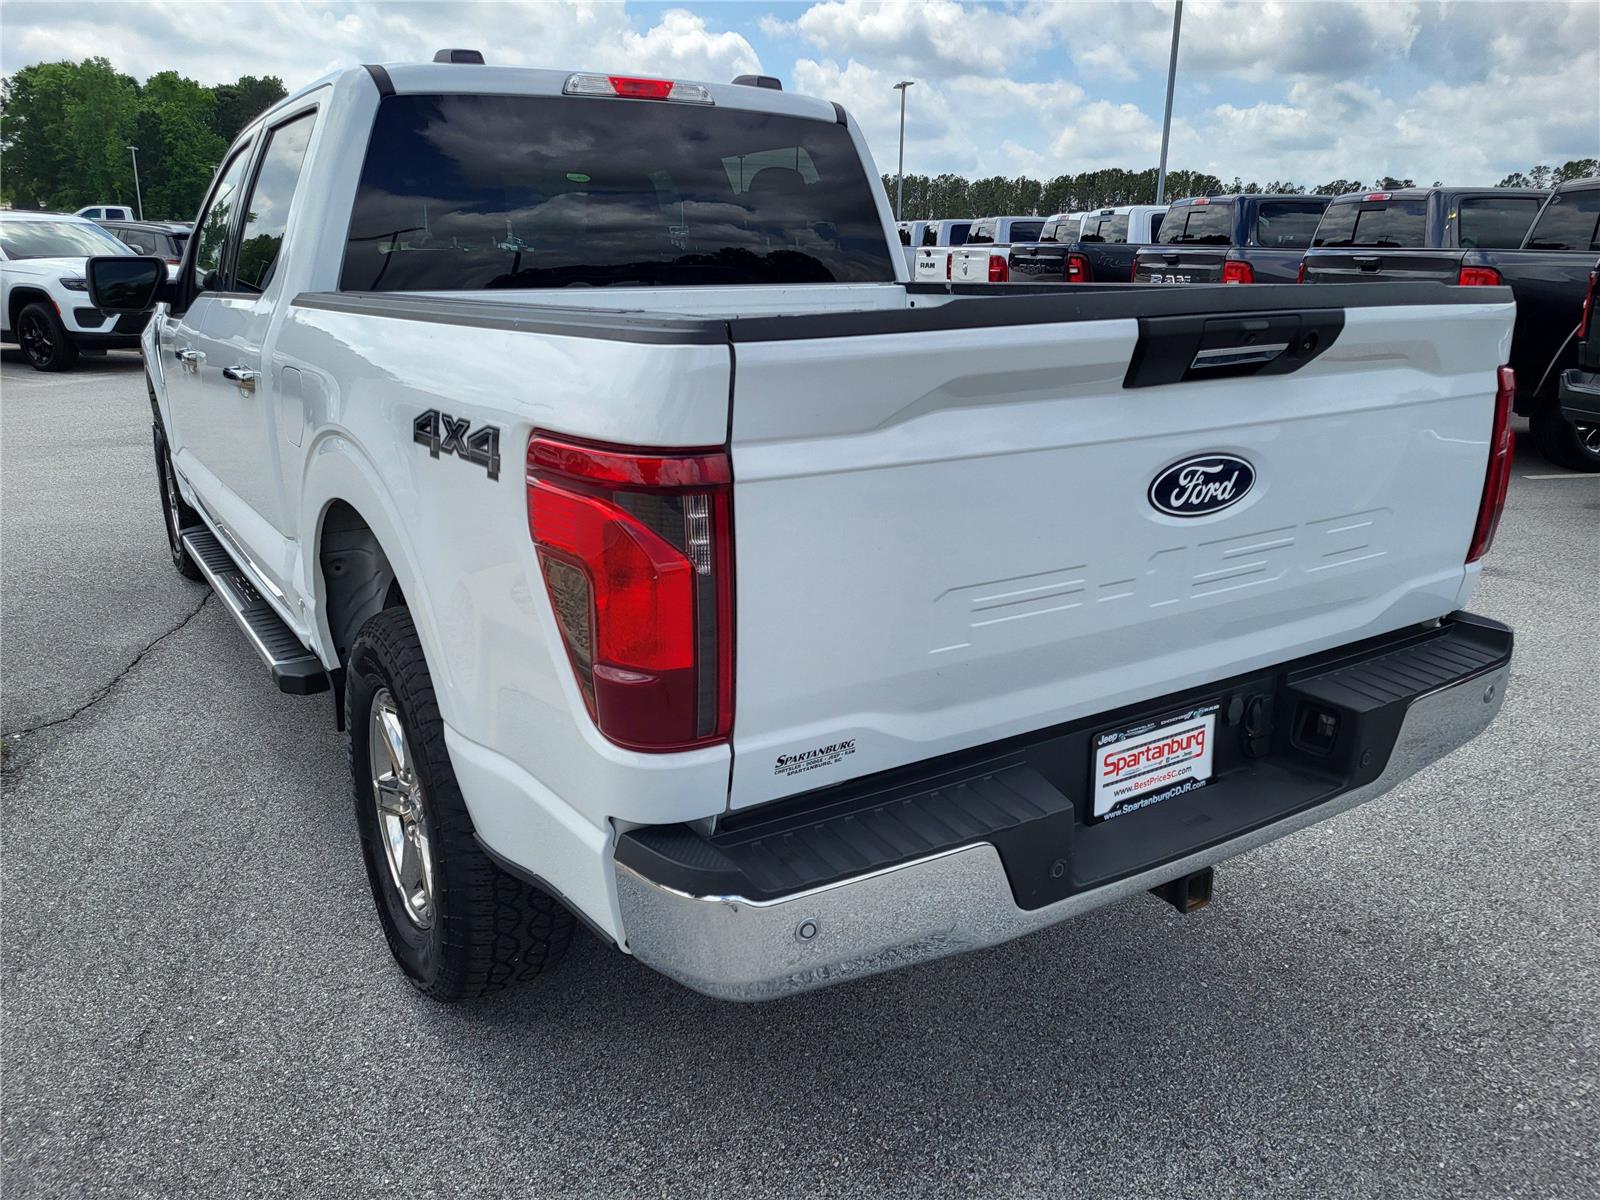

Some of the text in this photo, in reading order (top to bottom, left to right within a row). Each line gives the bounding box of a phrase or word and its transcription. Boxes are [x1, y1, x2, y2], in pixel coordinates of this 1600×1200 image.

[1170, 464, 1239, 507] Ford
[1098, 733, 1118, 746] Jeep
[1103, 729, 1206, 777] Spartanburg
[1103, 780, 1207, 820] www.SpartanburgCDJR.com
[1113, 765, 1193, 798] www.BestPriceSC.com
